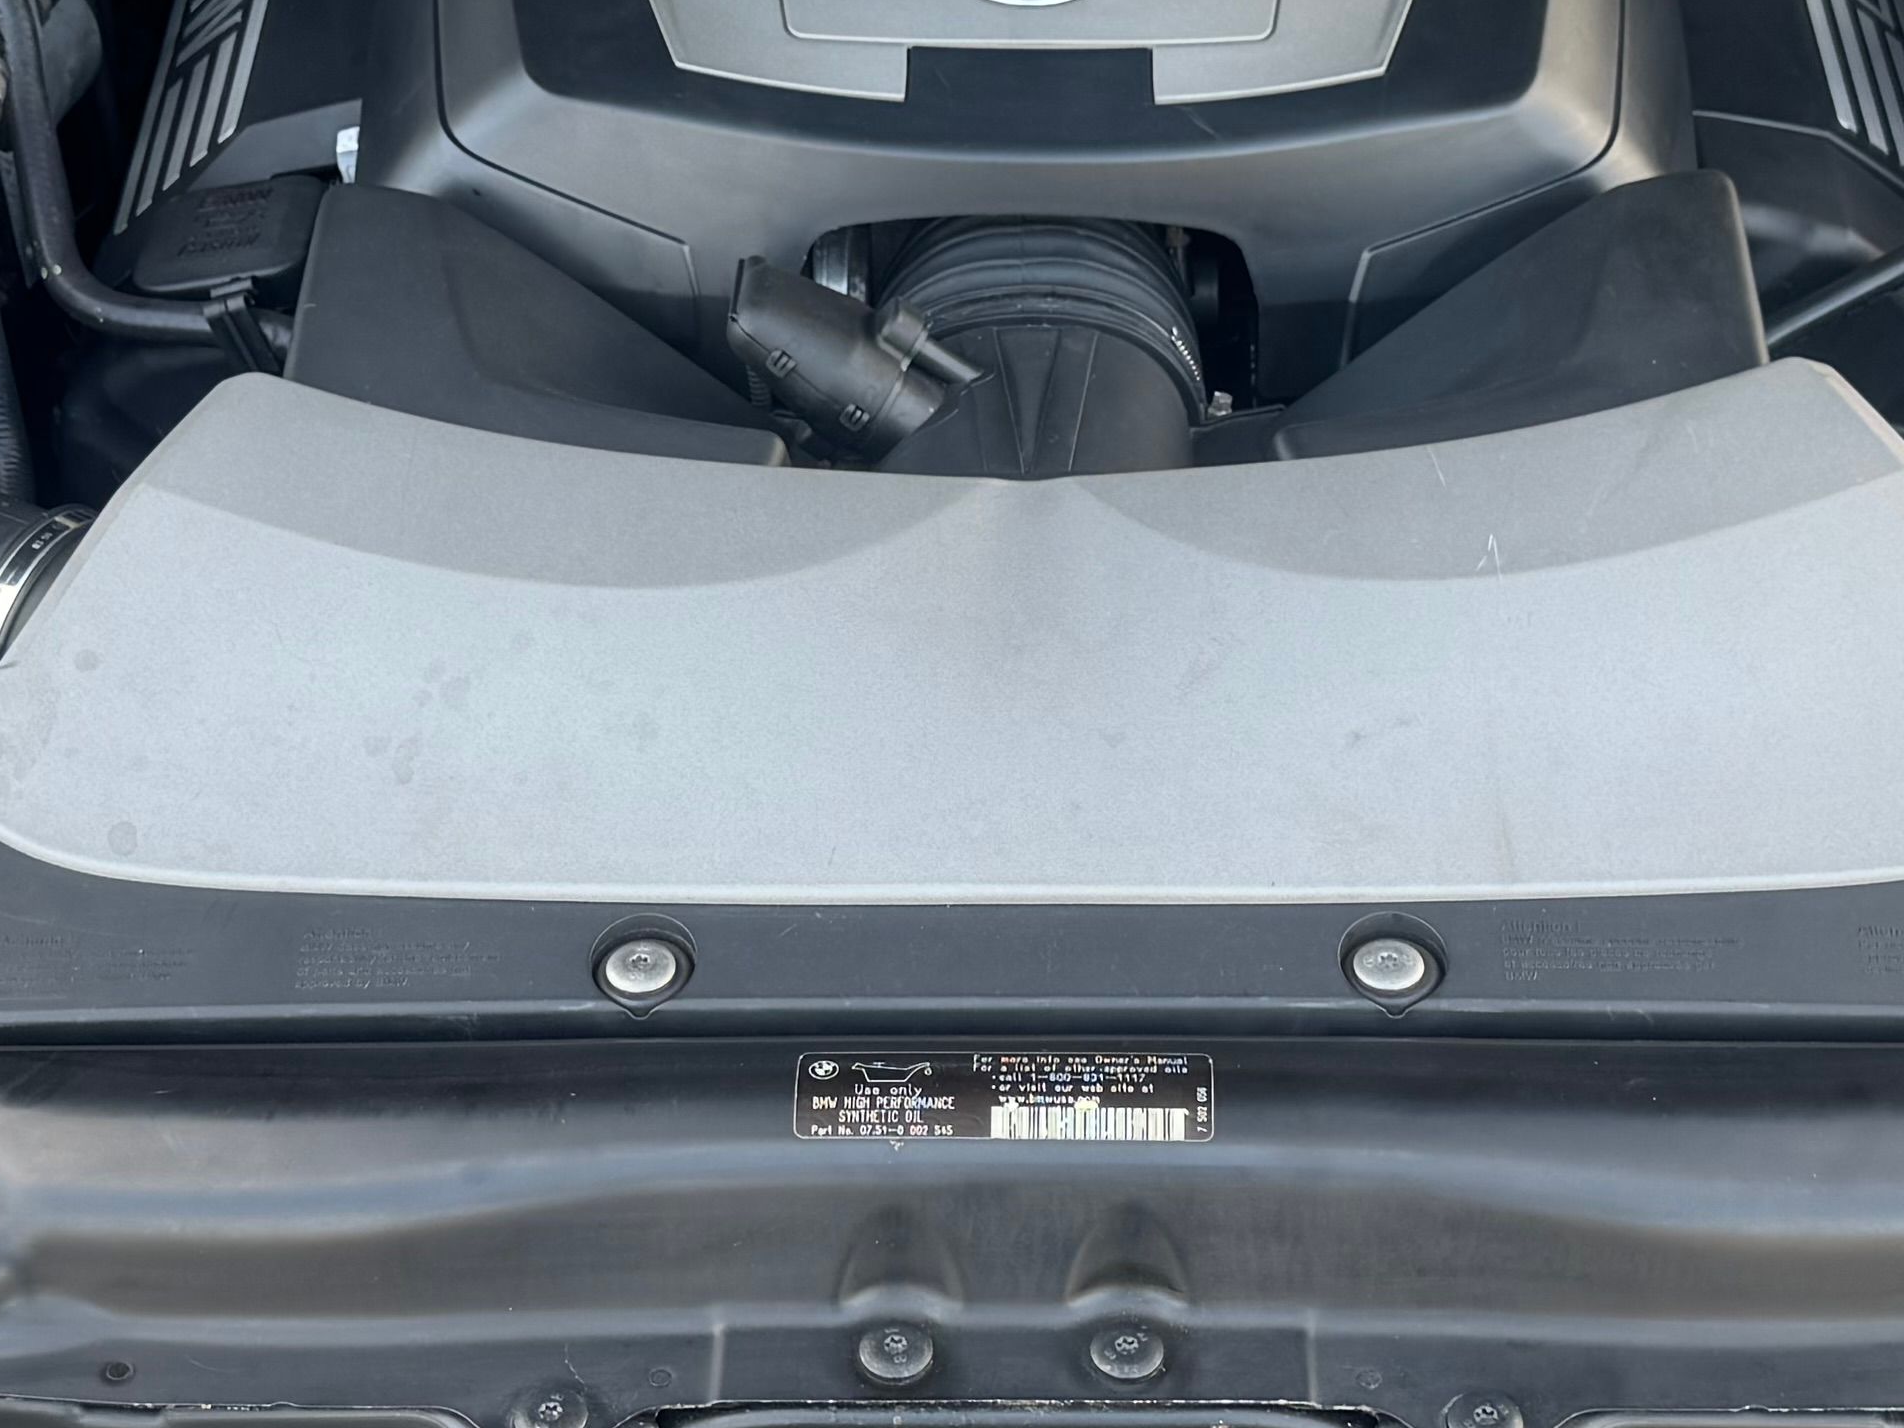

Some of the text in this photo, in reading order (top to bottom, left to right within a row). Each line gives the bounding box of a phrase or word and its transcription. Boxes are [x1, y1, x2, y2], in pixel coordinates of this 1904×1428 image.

[854, 1083, 922, 1097] Use only
[812, 1096, 956, 1109] BMW HIGH PERFORMANCE
[839, 1110, 924, 1123] SYNTHETIC OIL
[811, 1125, 832, 1135] Part
